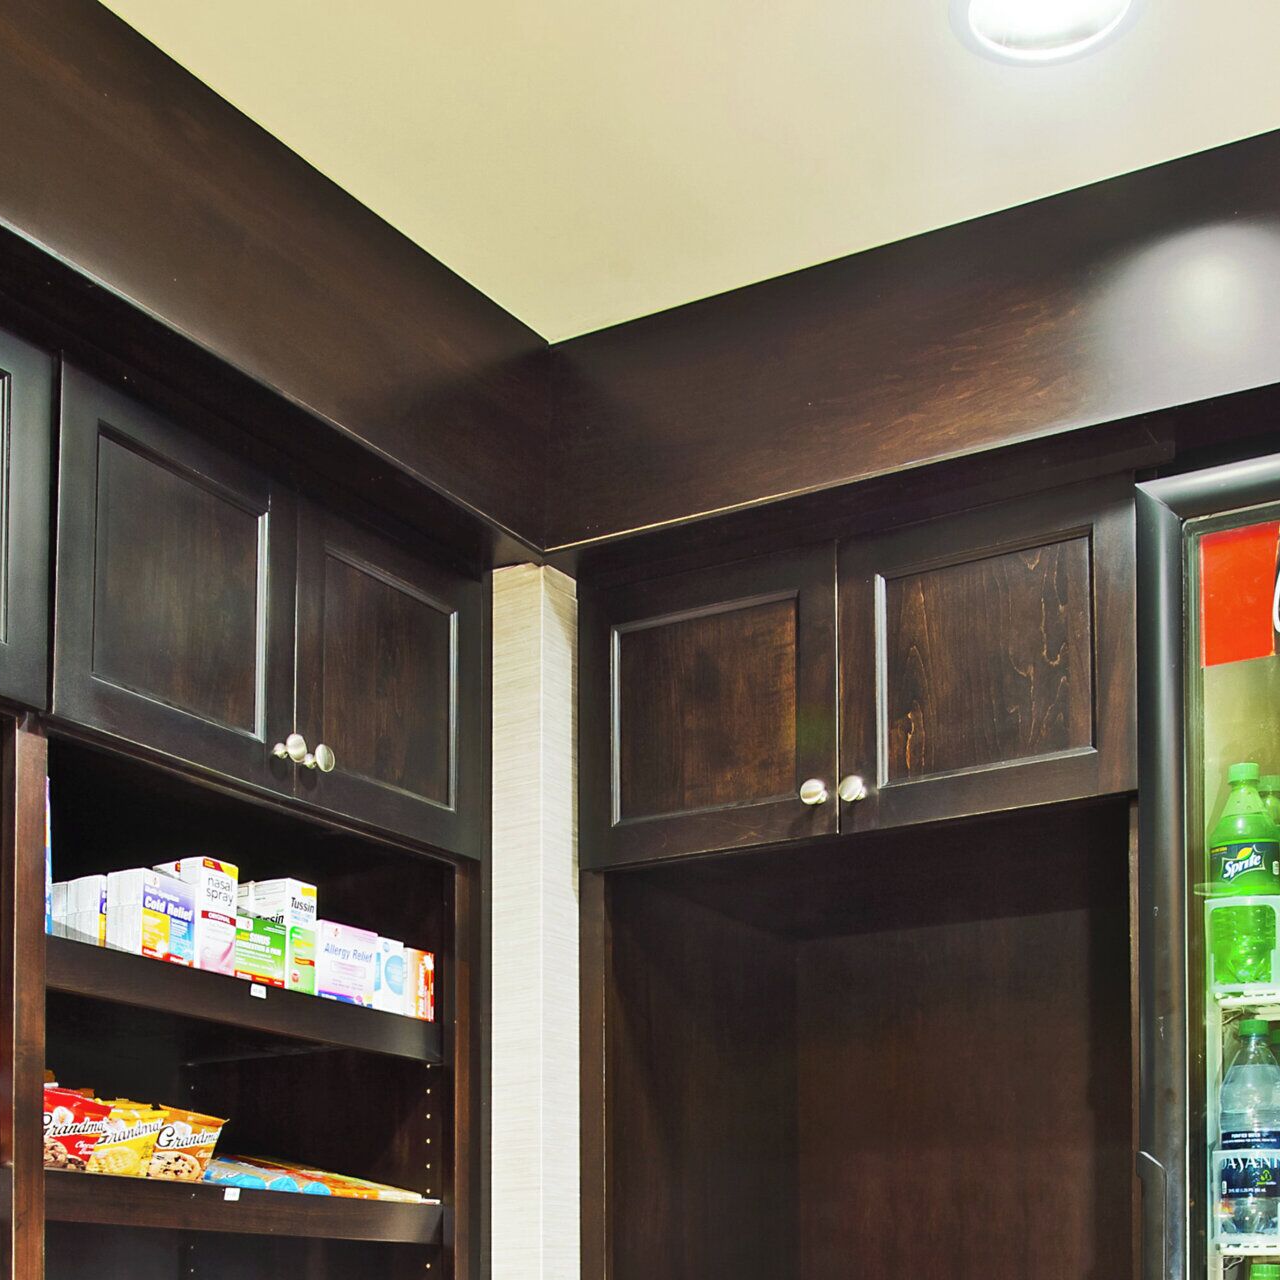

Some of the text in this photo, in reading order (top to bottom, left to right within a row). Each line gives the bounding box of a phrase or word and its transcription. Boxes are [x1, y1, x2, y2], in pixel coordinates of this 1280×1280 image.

[1223, 855, 1263, 880] Sprite
[207, 876, 233, 892] nasal
[206, 888, 234, 907] spray
[291, 896, 315, 914] Tussin
[144, 897, 194, 922] Cold Relief
[323, 942, 374, 963] Allergy Relief
